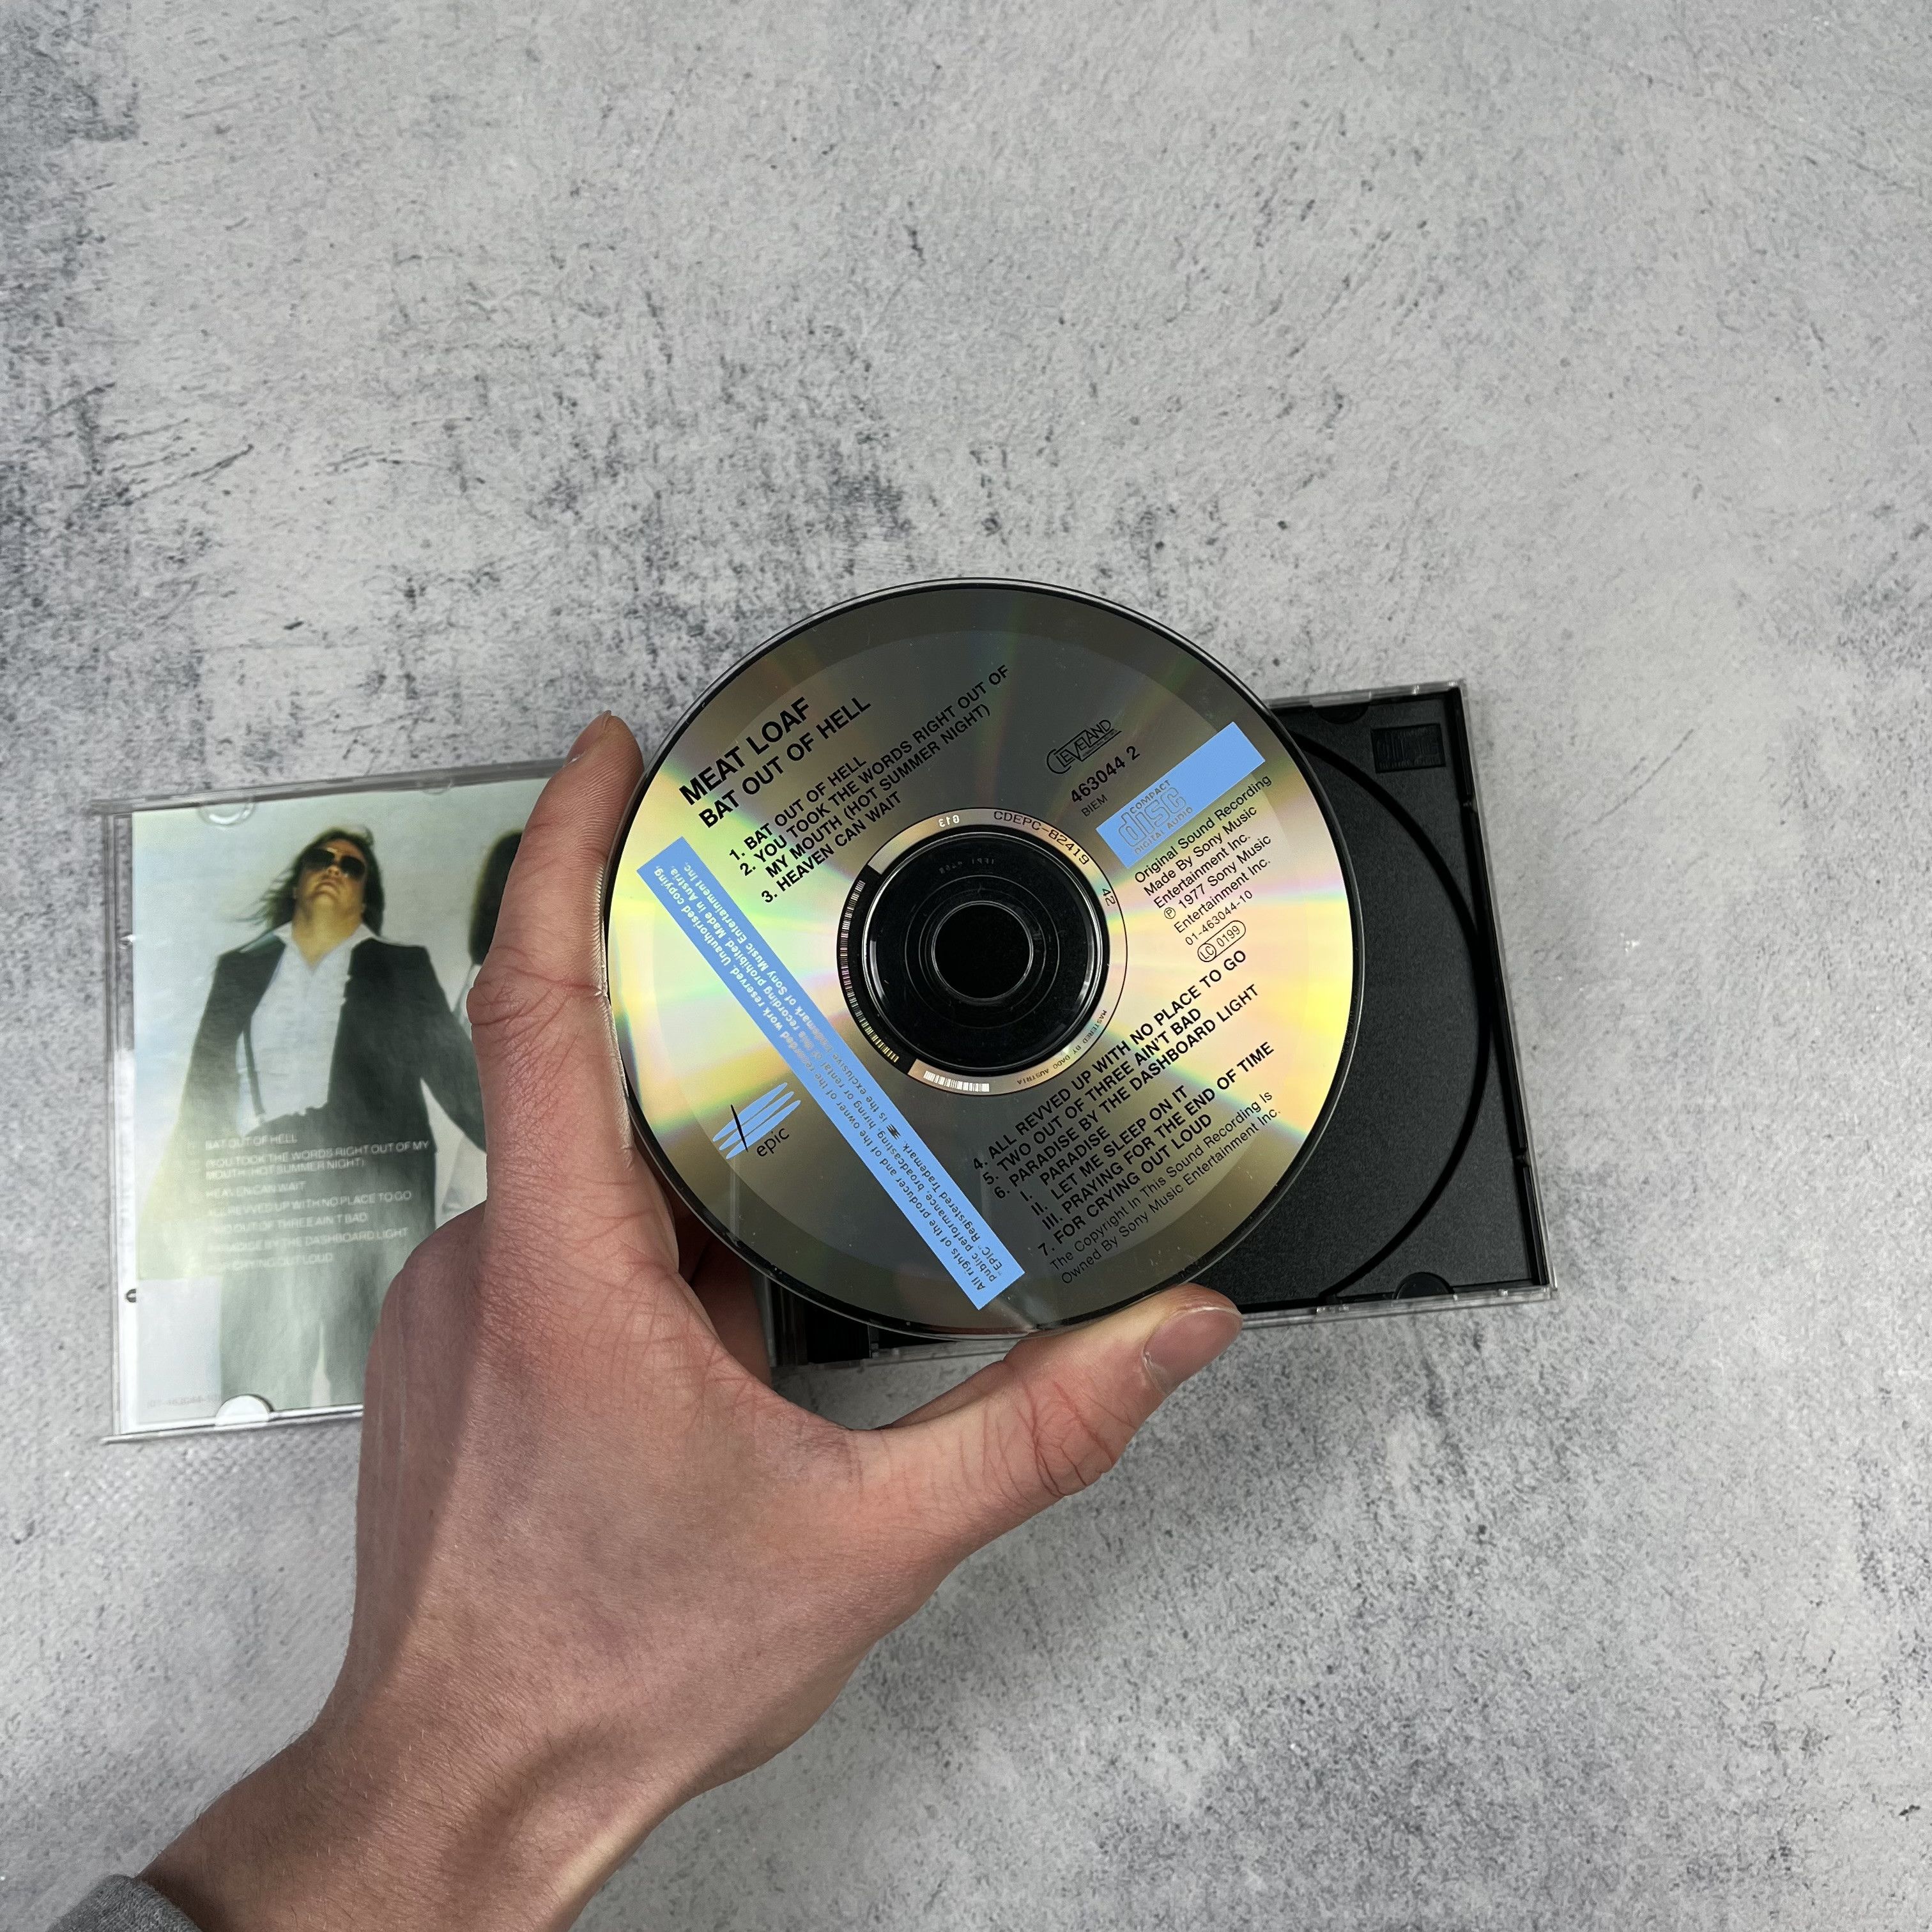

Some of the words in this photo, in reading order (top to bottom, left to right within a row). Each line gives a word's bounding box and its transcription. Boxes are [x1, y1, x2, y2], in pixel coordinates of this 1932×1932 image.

[678, 745, 746, 806] MEAT
[745, 696, 810, 756] LOAF
[698, 788, 740, 829] BAT
[741, 755, 785, 795] OUT
[786, 732, 815, 762] OF
[815, 696, 872, 740] HELL
[739, 862, 757, 877] 2.
[753, 834, 788, 864] YOU
[785, 802, 832, 839] TOOK
[827, 779, 861, 807] THE
[856, 740, 913, 785] WORDS
[911, 704, 956, 745] RIGHT
[956, 680, 987, 710] OUT
[988, 664, 1009, 686] OF
[1070, 755, 1126, 803] 463044
[1125, 745, 1141, 762] 2
[728, 848, 746, 861] 1.
[742, 822, 774, 851] BAT
[774, 797, 805, 827] OUT
[805, 781, 827, 804] OF
[826, 756, 868, 788] HELL
[764, 854, 789, 879] MY
[788, 815, 843, 861] MOUTH
[843, 786, 878, 821] (HOT
[878, 740, 941, 792] SUMMER
[939, 703, 991, 746] NIGHT)
[1080, 793, 1109, 818] BIEM
[1130, 779, 1170, 813] COMPACT
[760, 889, 779, 903] 3.
[775, 843, 835, 893] HEAVEN
[834, 818, 867, 847] CAN
[863, 790, 901, 824] WAIT
[993, 811, 1089, 865] CDEPC-82419
[1133, 827, 1166, 854] DIGITAL
[1167, 806, 1193, 829] AUDIO
[1134, 845, 1179, 884] Original
[1177, 816, 1216, 850] Sound
[1213, 775, 1273, 822] Recording
[1142, 869, 1177, 897] Made
[1174, 855, 1193, 872] By
[1192, 832, 1223, 858] Sony
[1221, 806, 1257, 836] Music
[683, 861, 698, 882] Inc.
[1153, 847, 1230, 909] Entertainment
[1226, 834, 1251, 852] Inc.
[1177, 882, 1206, 909] 1977
[1206, 861, 1238, 887] Sony
[1235, 835, 1272, 865] Music
[694, 879, 747, 944] Entertainment
[1173, 871, 1250, 934] Entertainment
[1246, 858, 1271, 877] Inc.
[1184, 889, 1254, 946] 01-463044-10
[680, 904, 732, 966] Unauthorised
[704, 911, 727, 939] Made
[1199, 945, 1216, 961] LC
[1215, 924, 1241, 948] 0199
[724, 937, 766, 987] prohibited.
[744, 942, 769, 972] Music
[729, 964, 765, 1008] reserved.
[765, 970, 788, 996] Sony
[783, 994, 797, 1006] of
[762, 985, 801, 1031] recording
[762, 1006, 784, 1032] work
[832, 1052, 867, 1096] exclusive
[972, 1157, 989, 1170] 4.
[988, 1133, 1018, 1160] ALL
[1014, 1087, 1071, 1137] REVVED
[1070, 1069, 1092, 1091] UP
[1091, 1039, 1132, 1074] WITH
[1128, 1022, 1154, 1046] NO
[1153, 984, 1202, 1027] PLACE
[1198, 969, 1222, 988] TO
[1223, 949, 1246, 972] GO
[824, 1088, 838, 1101] of
[843, 1089, 854, 1101] or
[852, 1099, 877, 1130] hiring
[866, 1098, 880, 1113] the
[981, 1170, 1000, 1186] 5.
[995, 1142, 1032, 1172] TWO
[1032, 1114, 1063, 1145] OUT
[1064, 1096, 1085, 1120] OF
[1084, 1059, 1135, 1102] THREE
[1133, 1029, 1170, 1067] AIN'T
[1169, 1008, 1202, 1037] BAD
[993, 1185, 1011, 1200] 6.
[1008, 1126, 1080, 1188] PARADISE
[1077, 1108, 1100, 1133] BY
[1098, 1085, 1131, 1114] THE
[1128, 1018, 1216, 1092] DASHBOARD
[1215, 983, 1259, 1023] LIGHT
[835, 1101, 861, 1130] owner
[857, 1129, 873, 1147] the
[878, 1111, 888, 1123] is
[1041, 1212, 1064, 1231] III.
[1061, 1162, 1124, 1215] PRAYING
[1122, 1135, 1157, 1166] FOR
[1153, 1110, 1186, 1139] THE
[1183, 1087, 1216, 1117] END
[1216, 1068, 1237, 1091] OF
[1236, 1041, 1275, 1073] TIME
[756, 1128, 789, 1157] epic
[870, 1146, 882, 1158] of
[1030, 1200, 1049, 1217] II.
[1050, 1172, 1078, 1201] LET
[1078, 1153, 1105, 1178] ME
[1103, 1117, 1147, 1158] SLEEP
[1148, 1098, 1174, 1121] ON
[1170, 1084, 1188, 1104] IT
[1038, 1124, 1111, 1187] PARADISE
[878, 1157, 898, 1177] and
[1036, 1241, 1055, 1257] 7.
[1052, 1215, 1087, 1245] FOR
[1085, 1171, 1141, 1218] CRYING
[1140, 1144, 1171, 1174] OUT
[1170, 1113, 1212, 1151] LOUD
[1048, 1251, 1075, 1271] The
[1073, 1205, 1130, 1253] Copyright
[1126, 1197, 1142, 1210] In
[1138, 1176, 1167, 1198] This
[1165, 1144, 1205, 1179] Sound
[1202, 1101, 1262, 1149] Recording
[1258, 1091, 1273, 1104] Is
[894, 1177, 931, 1220] producer
[937, 1190, 981, 1243] Registered
[1061, 1247, 1103, 1284] Owned
[1100, 1235, 1119, 1252] By
[1118, 1211, 1149, 1238] Sony
[1147, 1183, 1184, 1215] Music
[1181, 1122, 1260, 1186] Entertainment
[1256, 1108, 1280, 1127] Inc.
[928, 1218, 943, 1236] the
[939, 1236, 953, 1248] of
[950, 1247, 975, 1277] rights
[970, 1252, 997, 1283] public
[971, 1276, 986, 1291] All
